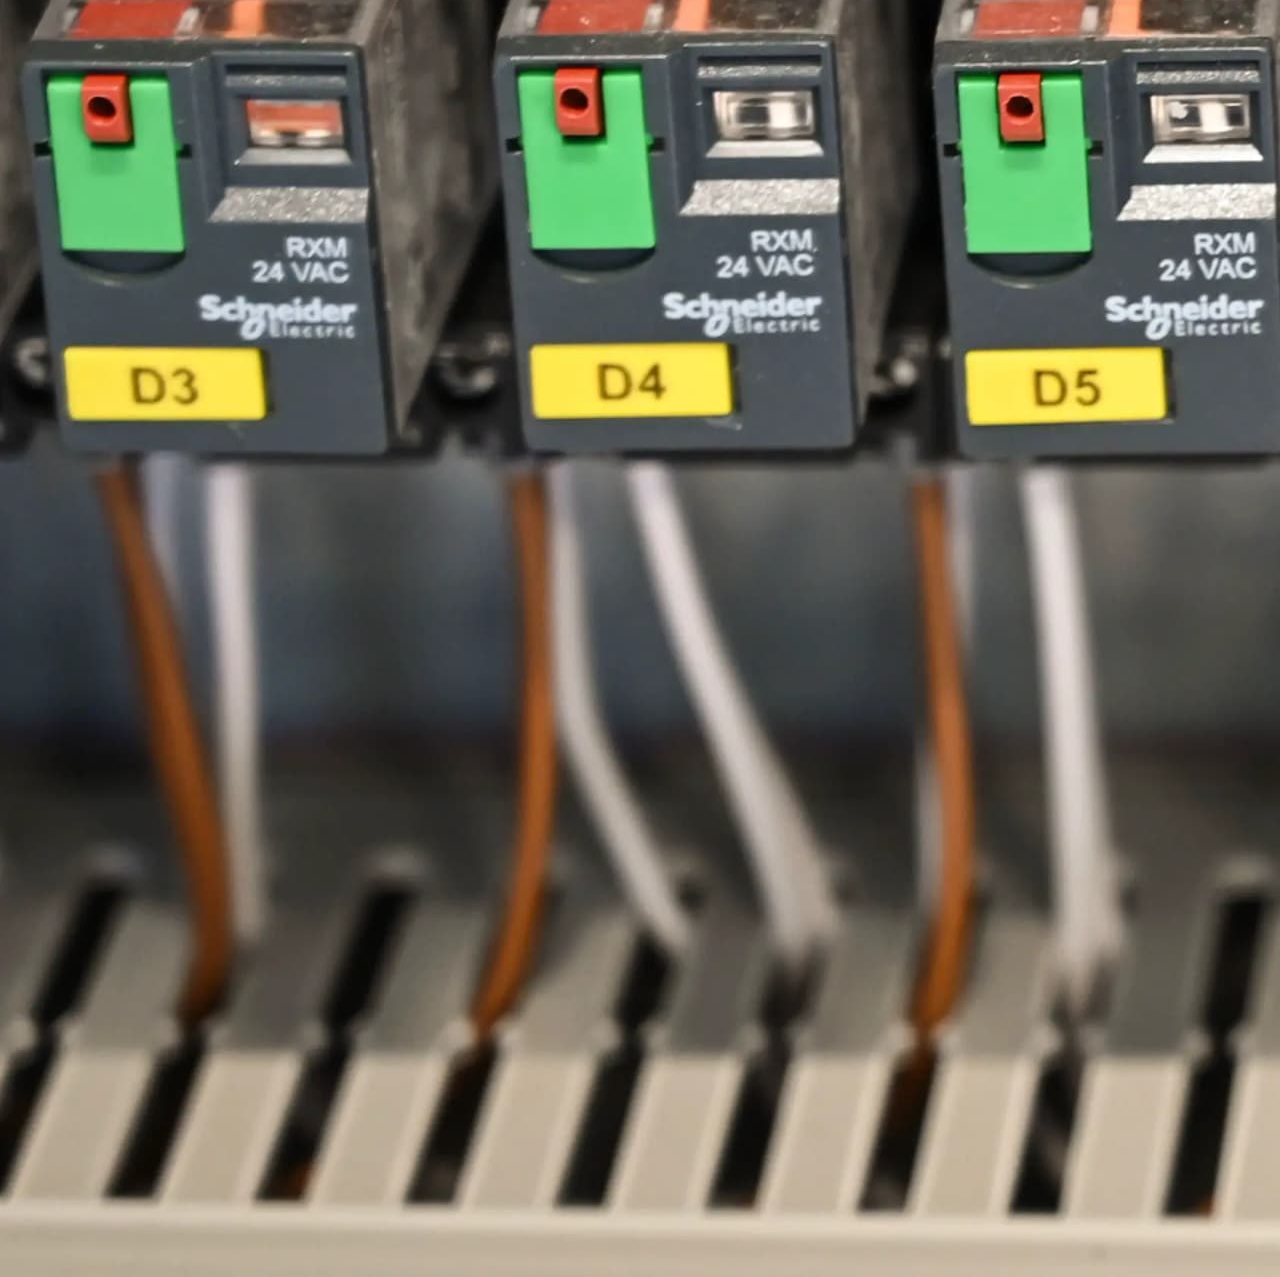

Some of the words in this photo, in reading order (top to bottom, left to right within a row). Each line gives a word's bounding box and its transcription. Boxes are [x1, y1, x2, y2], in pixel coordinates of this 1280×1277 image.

[286, 237, 347, 258] RXM
[751, 229, 812, 251] RXM
[1194, 232, 1255, 255] RXM
[253, 260, 285, 282] 24
[291, 261, 349, 283] VAC
[717, 256, 749, 278] 24
[755, 253, 814, 276] VAC
[1159, 259, 1192, 281] 24
[1198, 256, 1256, 279] VAC
[199, 295, 357, 321] Schneider
[663, 291, 822, 317] Schneider
[1105, 294, 1264, 320] Schneider
[269, 323, 354, 338] Electric
[732, 317, 820, 333] Electric
[1174, 318, 1260, 336] Electric
[131, 367, 198, 405] D3
[598, 363, 666, 400] D4
[1034, 369, 1101, 406] D5
